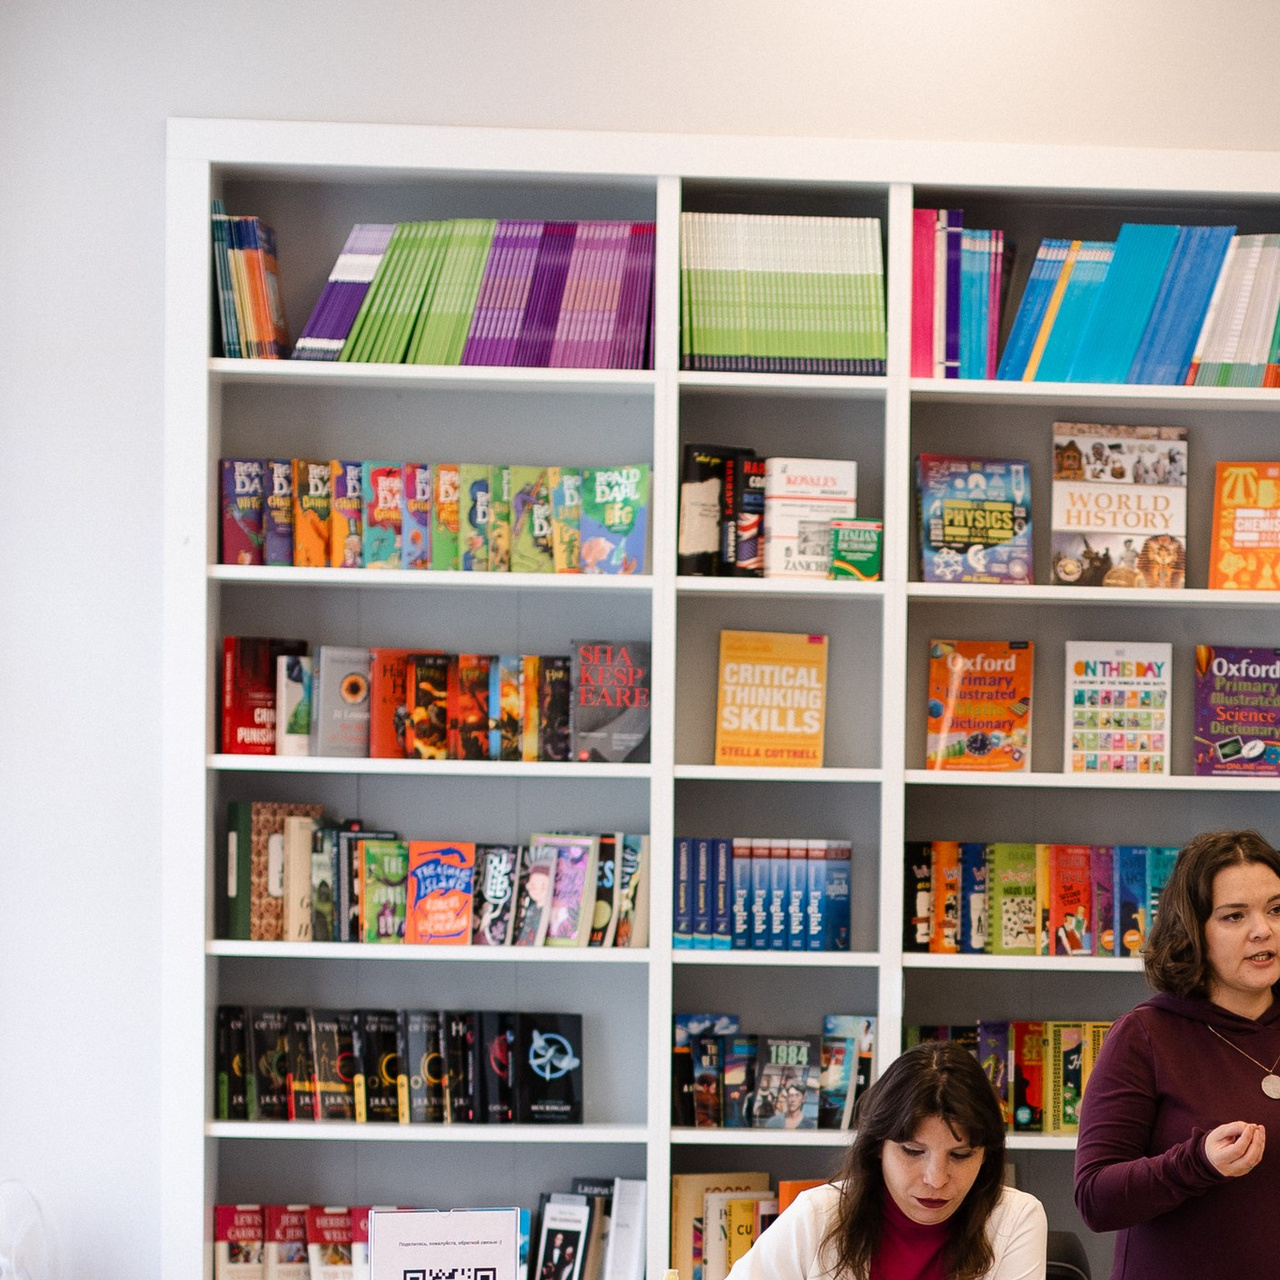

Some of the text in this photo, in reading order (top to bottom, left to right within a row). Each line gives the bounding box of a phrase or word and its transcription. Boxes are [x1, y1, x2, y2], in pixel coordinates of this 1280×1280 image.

[595, 468, 641, 485] ROALD
[595, 482, 641, 502] DAHL
[1068, 491, 1171, 511] WORLD
[605, 504, 633, 526] BFG
[944, 508, 1014, 530] PHYSICS
[1065, 509, 1174, 529] HISTORY
[579, 645, 632, 666] SHA
[946, 652, 1016, 672] Oxford
[579, 665, 644, 686] KESP
[723, 662, 822, 688] CRITICAL
[1074, 660, 1165, 678] ON THIS DAY
[1212, 657, 1280, 678] Oxford
[579, 686, 649, 707] EARE
[723, 684, 822, 709] THINKING
[1215, 677, 1278, 697] Primary
[1211, 692, 1280, 707] Illustrated
[721, 705, 820, 734] SKILLS
[1216, 706, 1276, 722] Science
[1210, 721, 1280, 739] Dictionary
[414, 864, 473, 882] TREASURE
[418, 877, 466, 899] ISLAND
[769, 1045, 809, 1065] 1984
